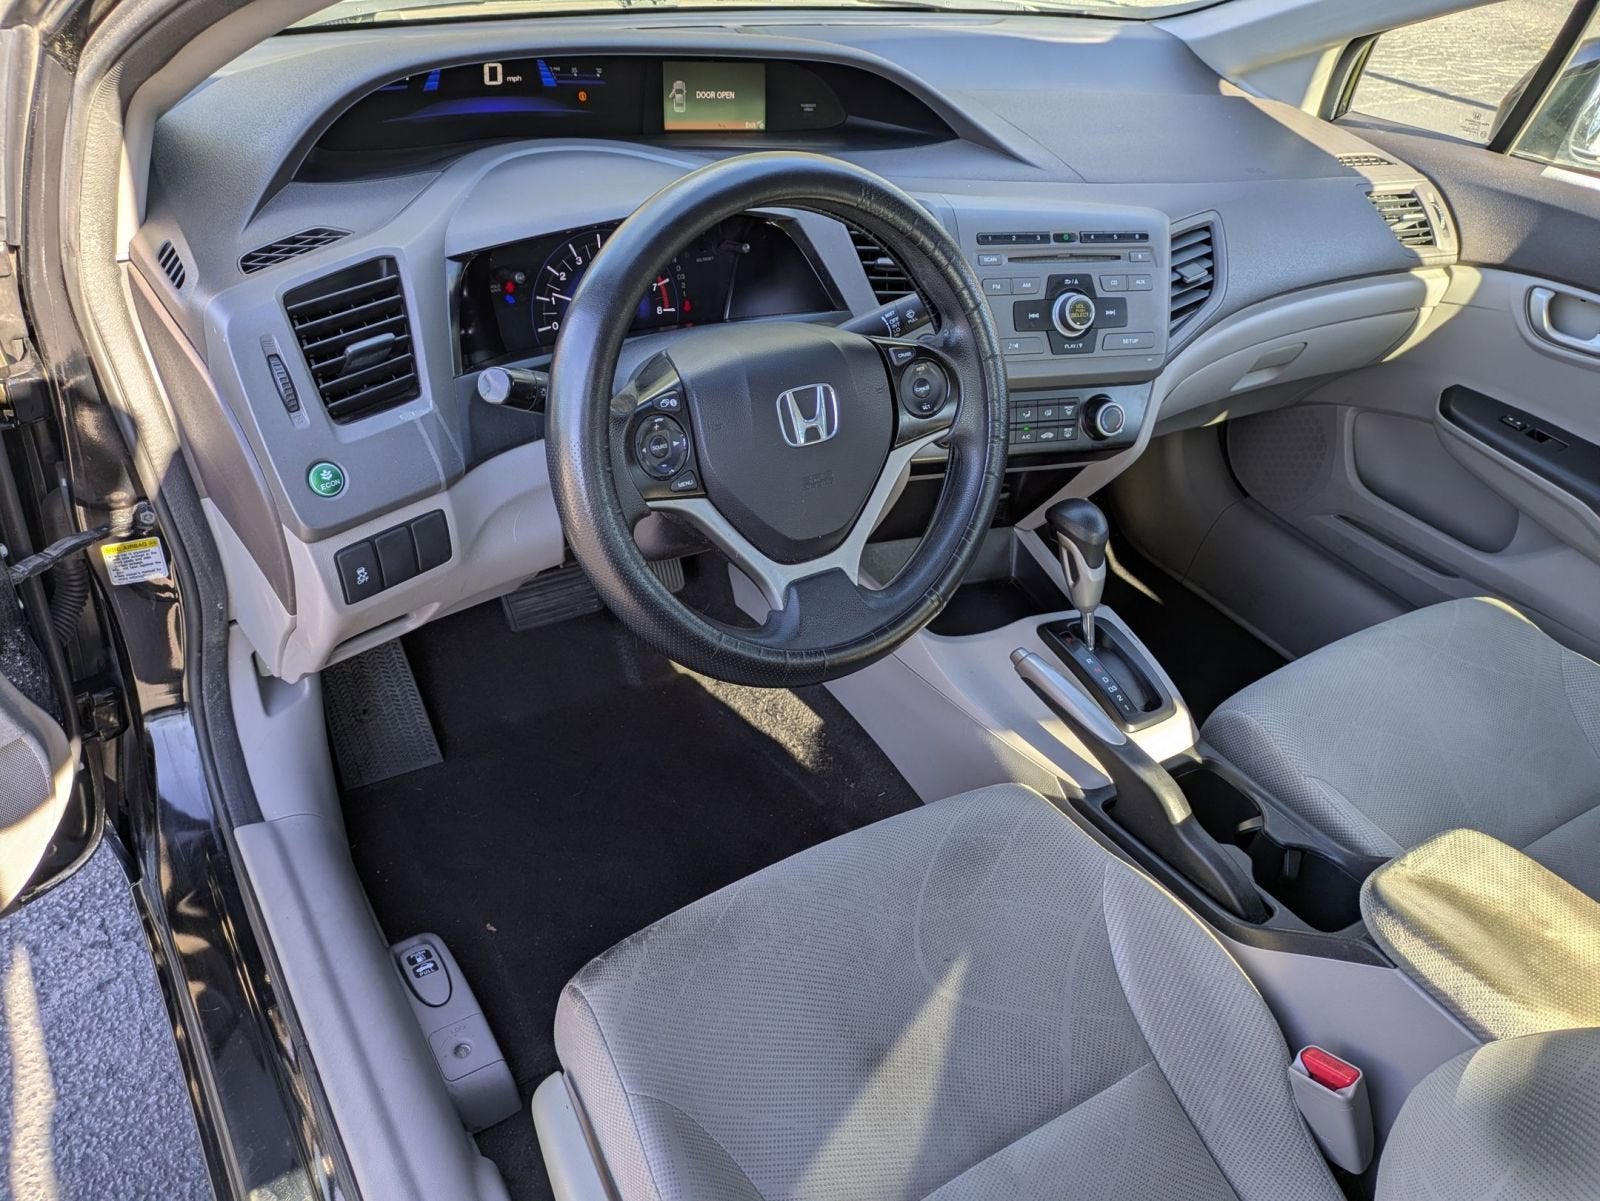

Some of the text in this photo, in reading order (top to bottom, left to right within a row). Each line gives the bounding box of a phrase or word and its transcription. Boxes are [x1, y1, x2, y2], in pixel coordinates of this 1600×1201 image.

[482, 62, 522, 86] 0 mph
[695, 90, 735, 99] DOOR OPEN
[576, 256, 583, 265] 3
[559, 272, 567, 281] 2
[652, 283, 658, 291] 7
[551, 297, 556, 305] 1
[656, 306, 663, 314] 8
[551, 321, 559, 330] 0
[889, 317, 899, 325] OFF
[320, 478, 341, 491] ECON
[677, 479, 693, 488] MENU
